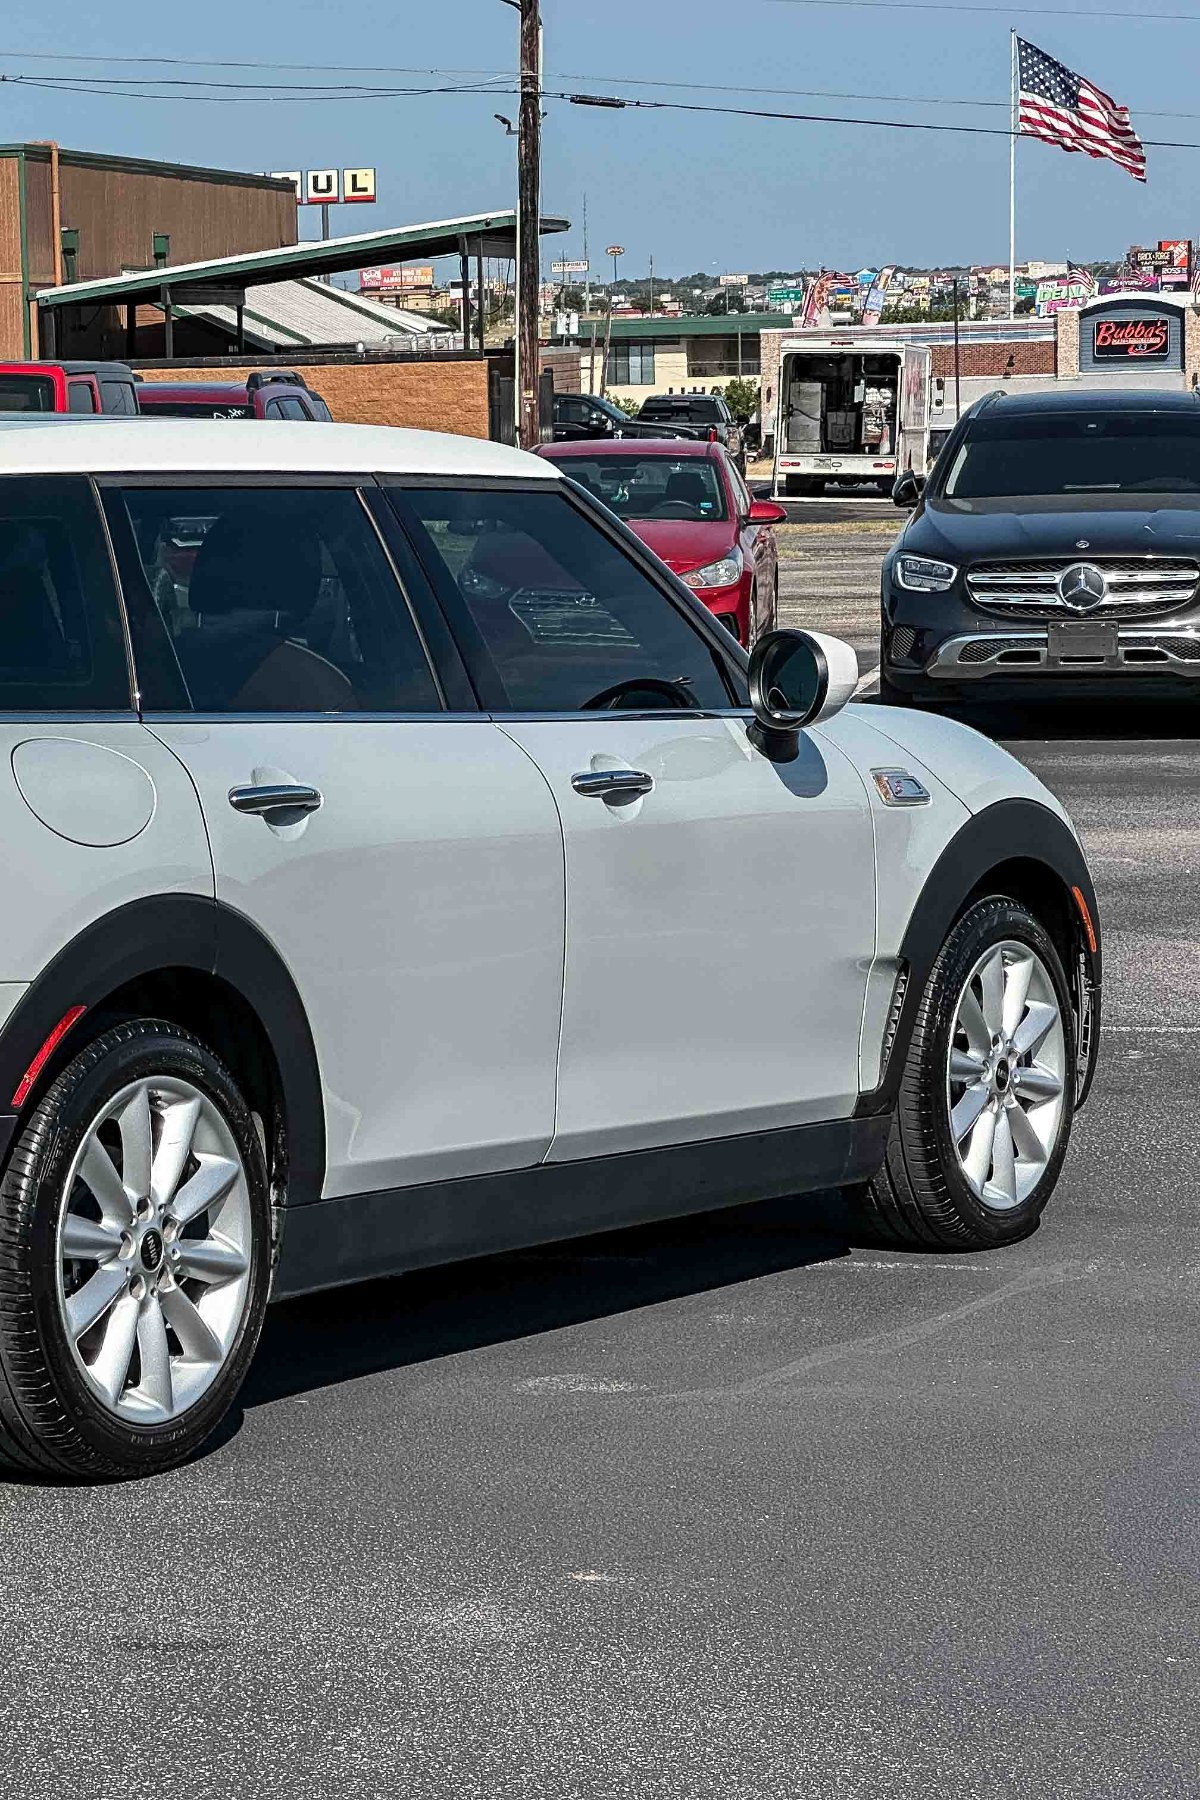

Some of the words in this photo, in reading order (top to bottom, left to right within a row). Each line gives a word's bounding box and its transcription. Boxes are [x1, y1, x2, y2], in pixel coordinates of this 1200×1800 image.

[280, 173, 369, 193] UL
[1038, 285, 1083, 303] DEAL
[1040, 282, 1056, 290] The
[1097, 320, 1168, 347] Bubba's
[146, 1234, 158, 1265] MINI
